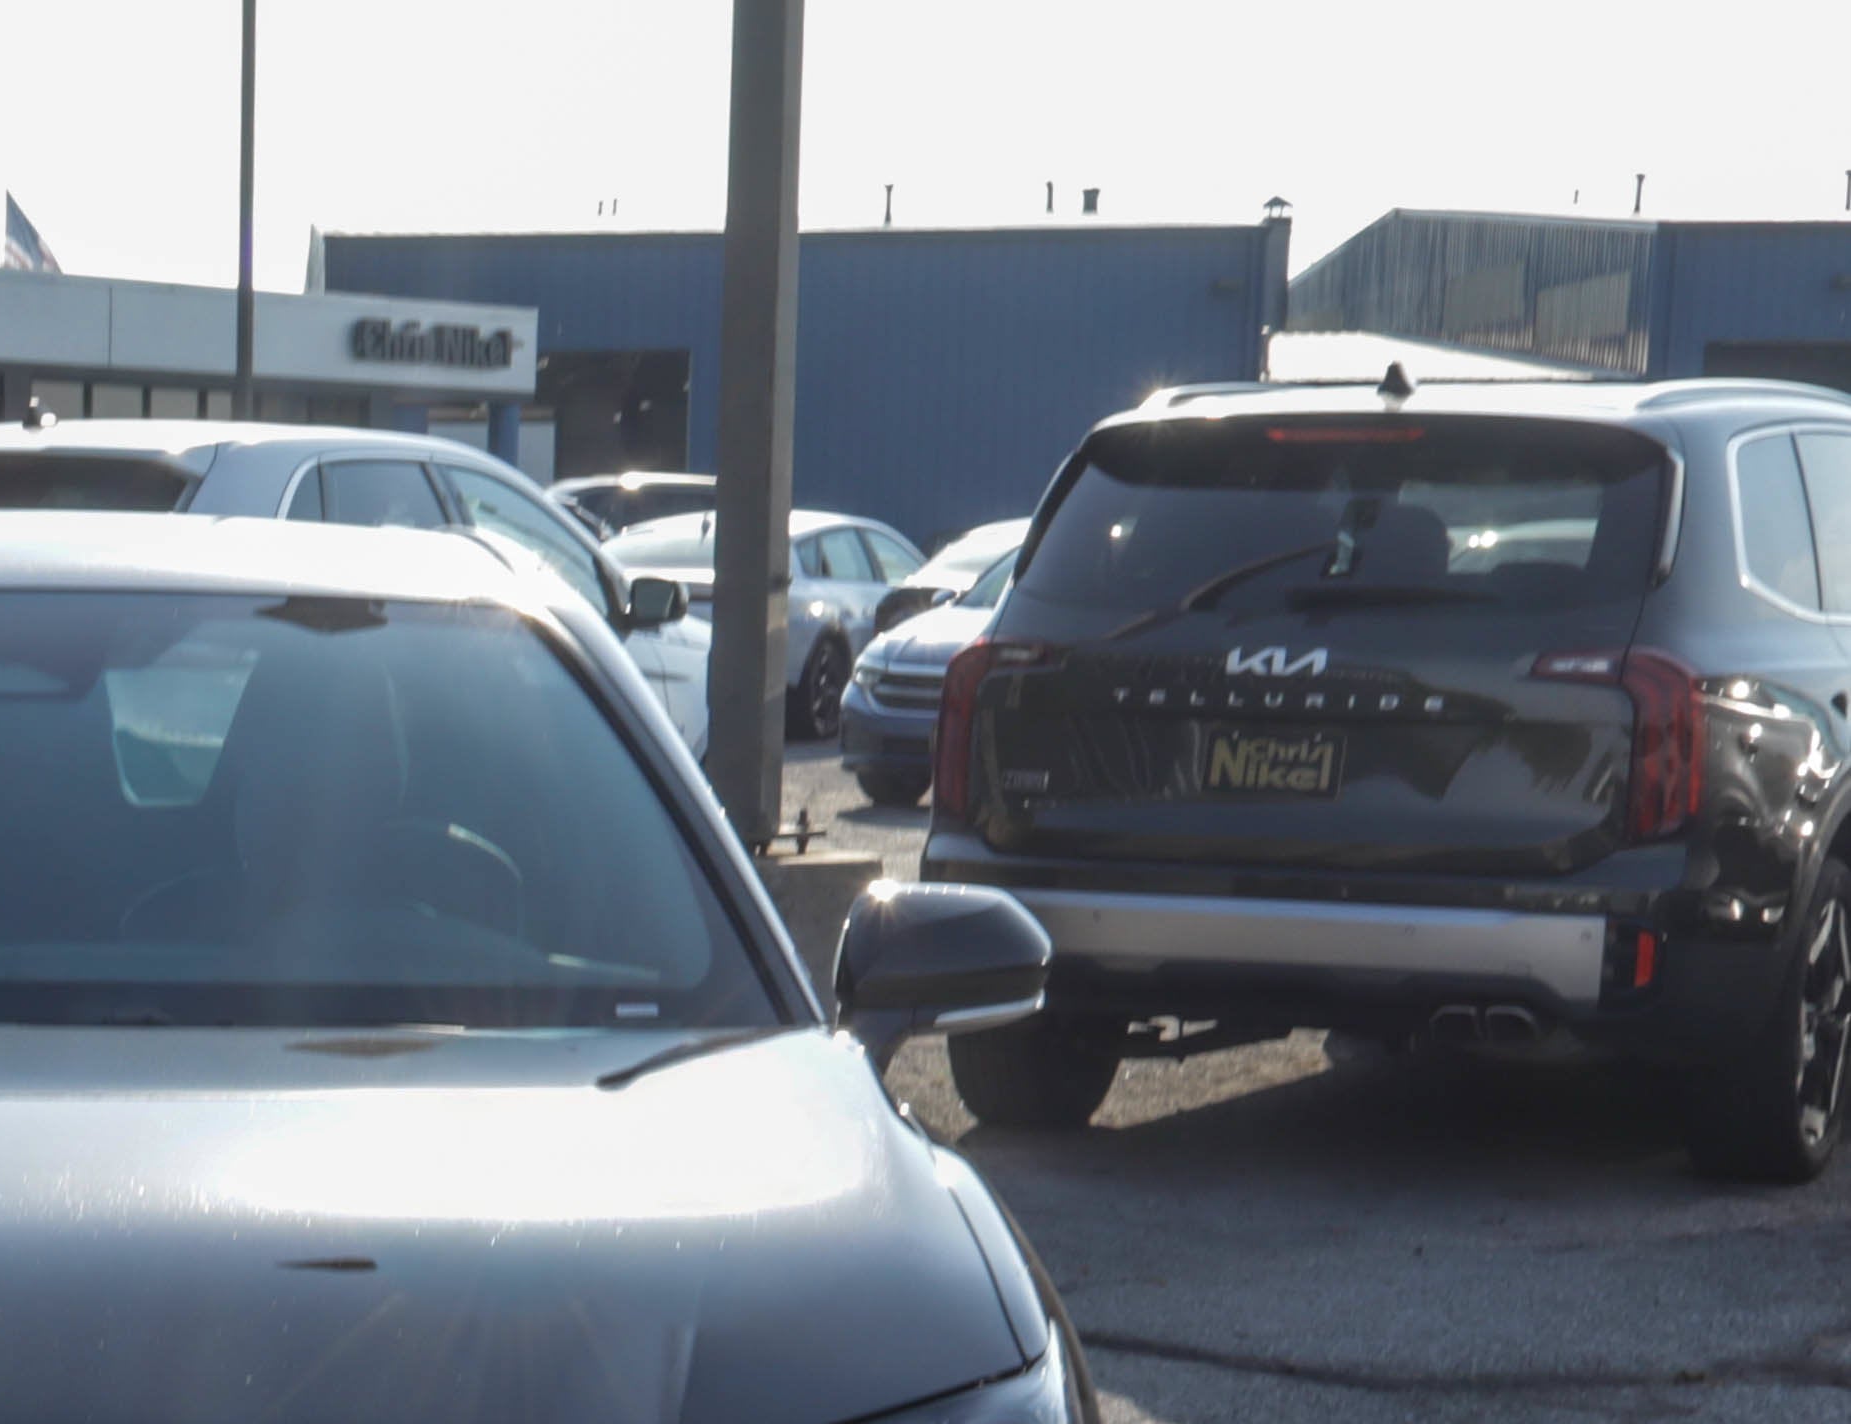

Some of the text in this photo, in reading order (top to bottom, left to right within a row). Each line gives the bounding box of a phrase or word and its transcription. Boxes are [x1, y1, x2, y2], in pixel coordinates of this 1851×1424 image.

[1226, 646, 1327, 676] KIA
[1114, 688, 1444, 712] TELLURIDE
[1249, 739, 1329, 762] Chris
[1210, 738, 1335, 791] Nikel
